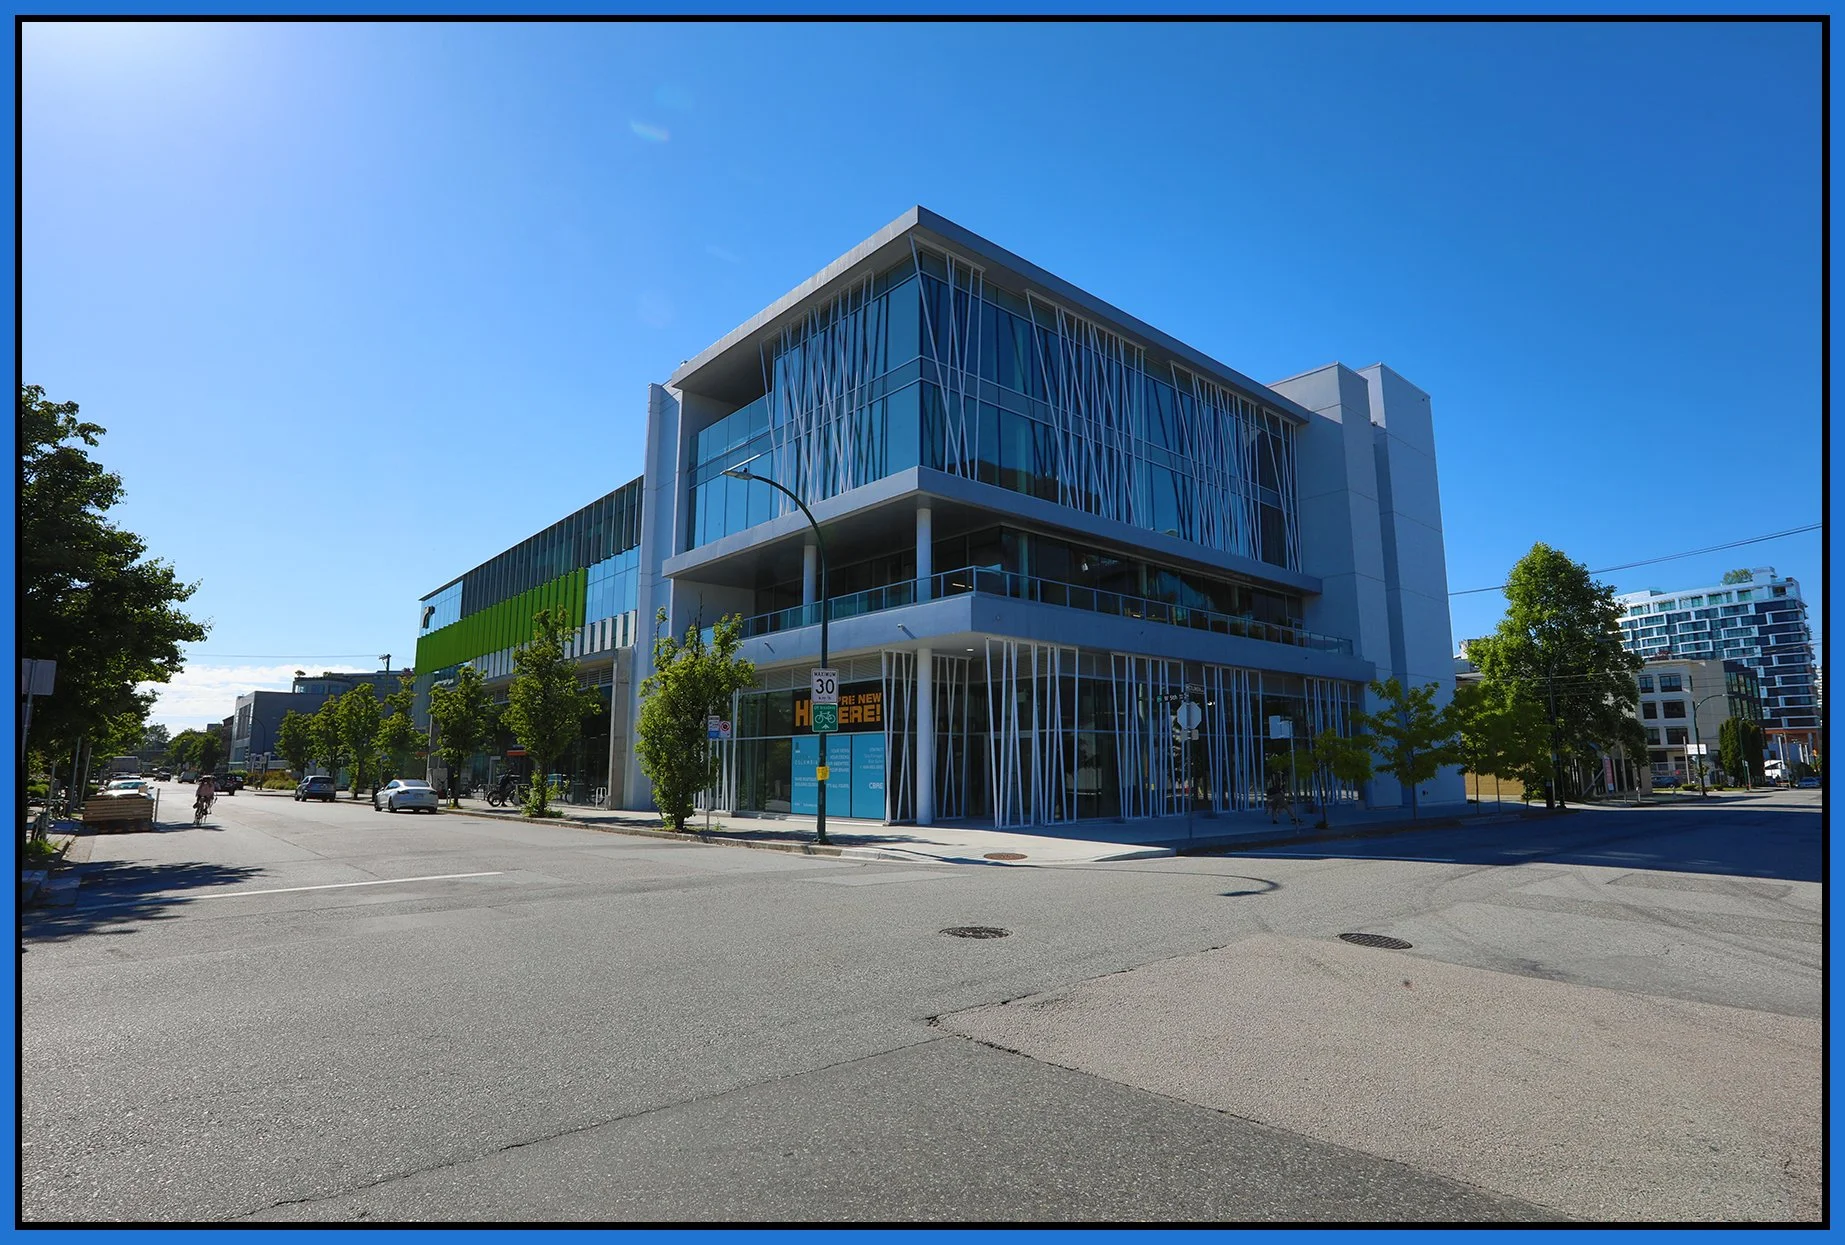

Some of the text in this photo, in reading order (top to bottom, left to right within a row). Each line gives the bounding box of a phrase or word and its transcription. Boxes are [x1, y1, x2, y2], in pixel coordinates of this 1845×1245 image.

[815, 678, 835, 694] 30
[858, 693, 881, 704] NEW
[839, 704, 881, 724] ERE!
